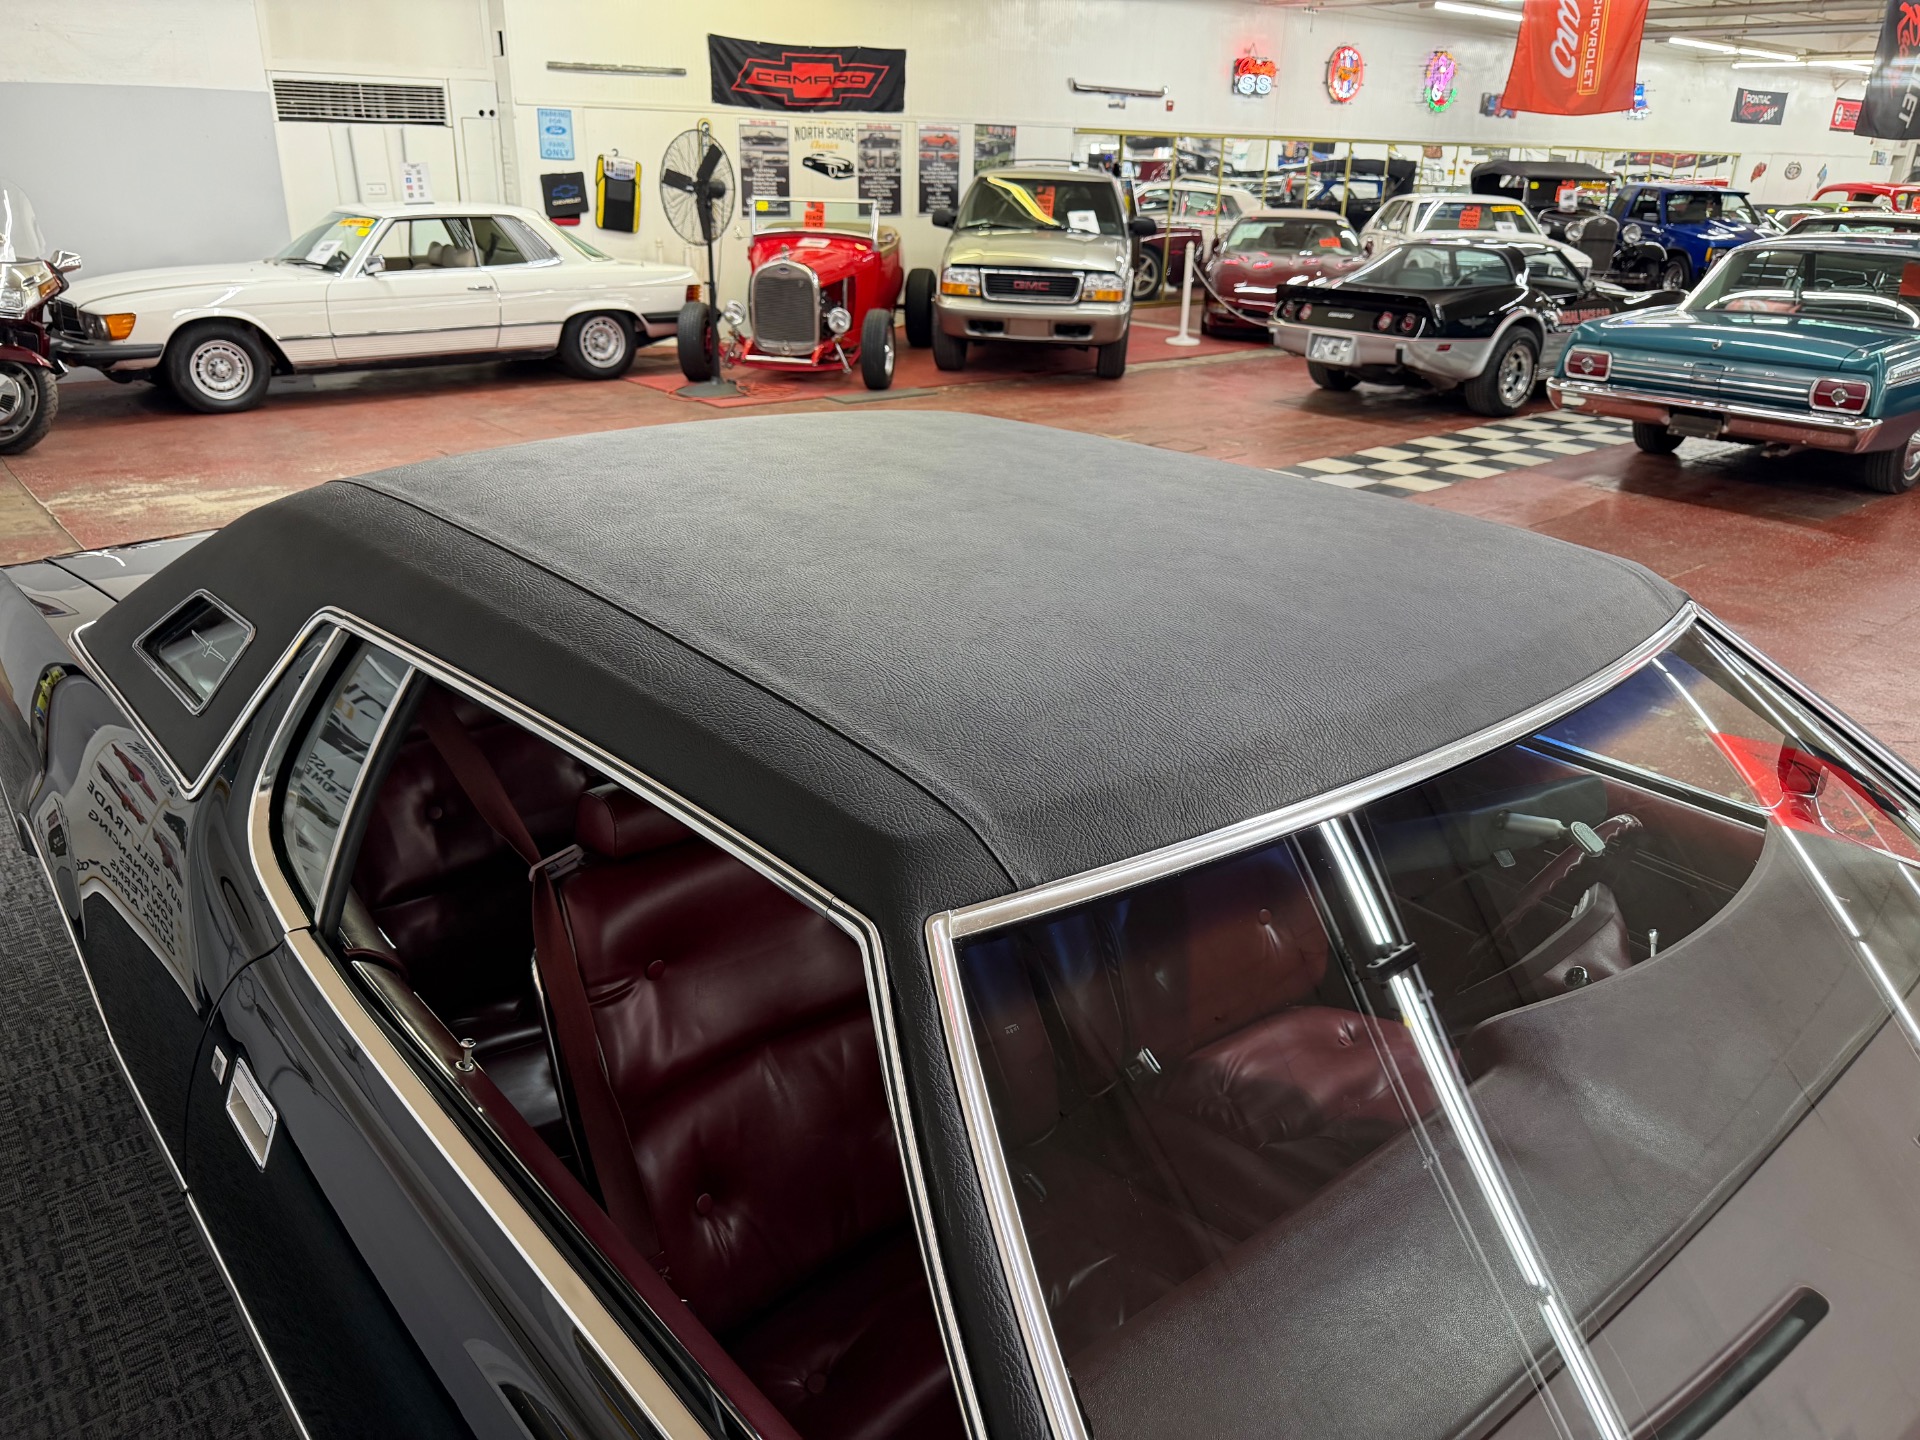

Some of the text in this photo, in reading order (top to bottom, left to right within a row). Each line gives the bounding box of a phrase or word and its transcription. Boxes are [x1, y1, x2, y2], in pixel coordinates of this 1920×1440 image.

[756, 71, 866, 85] CAMARO
[1238, 74, 1272, 95] SS
[794, 126, 856, 143] NORTH SHORE
[546, 149, 569, 157] ONLY
[1012, 280, 1051, 291] GMC
